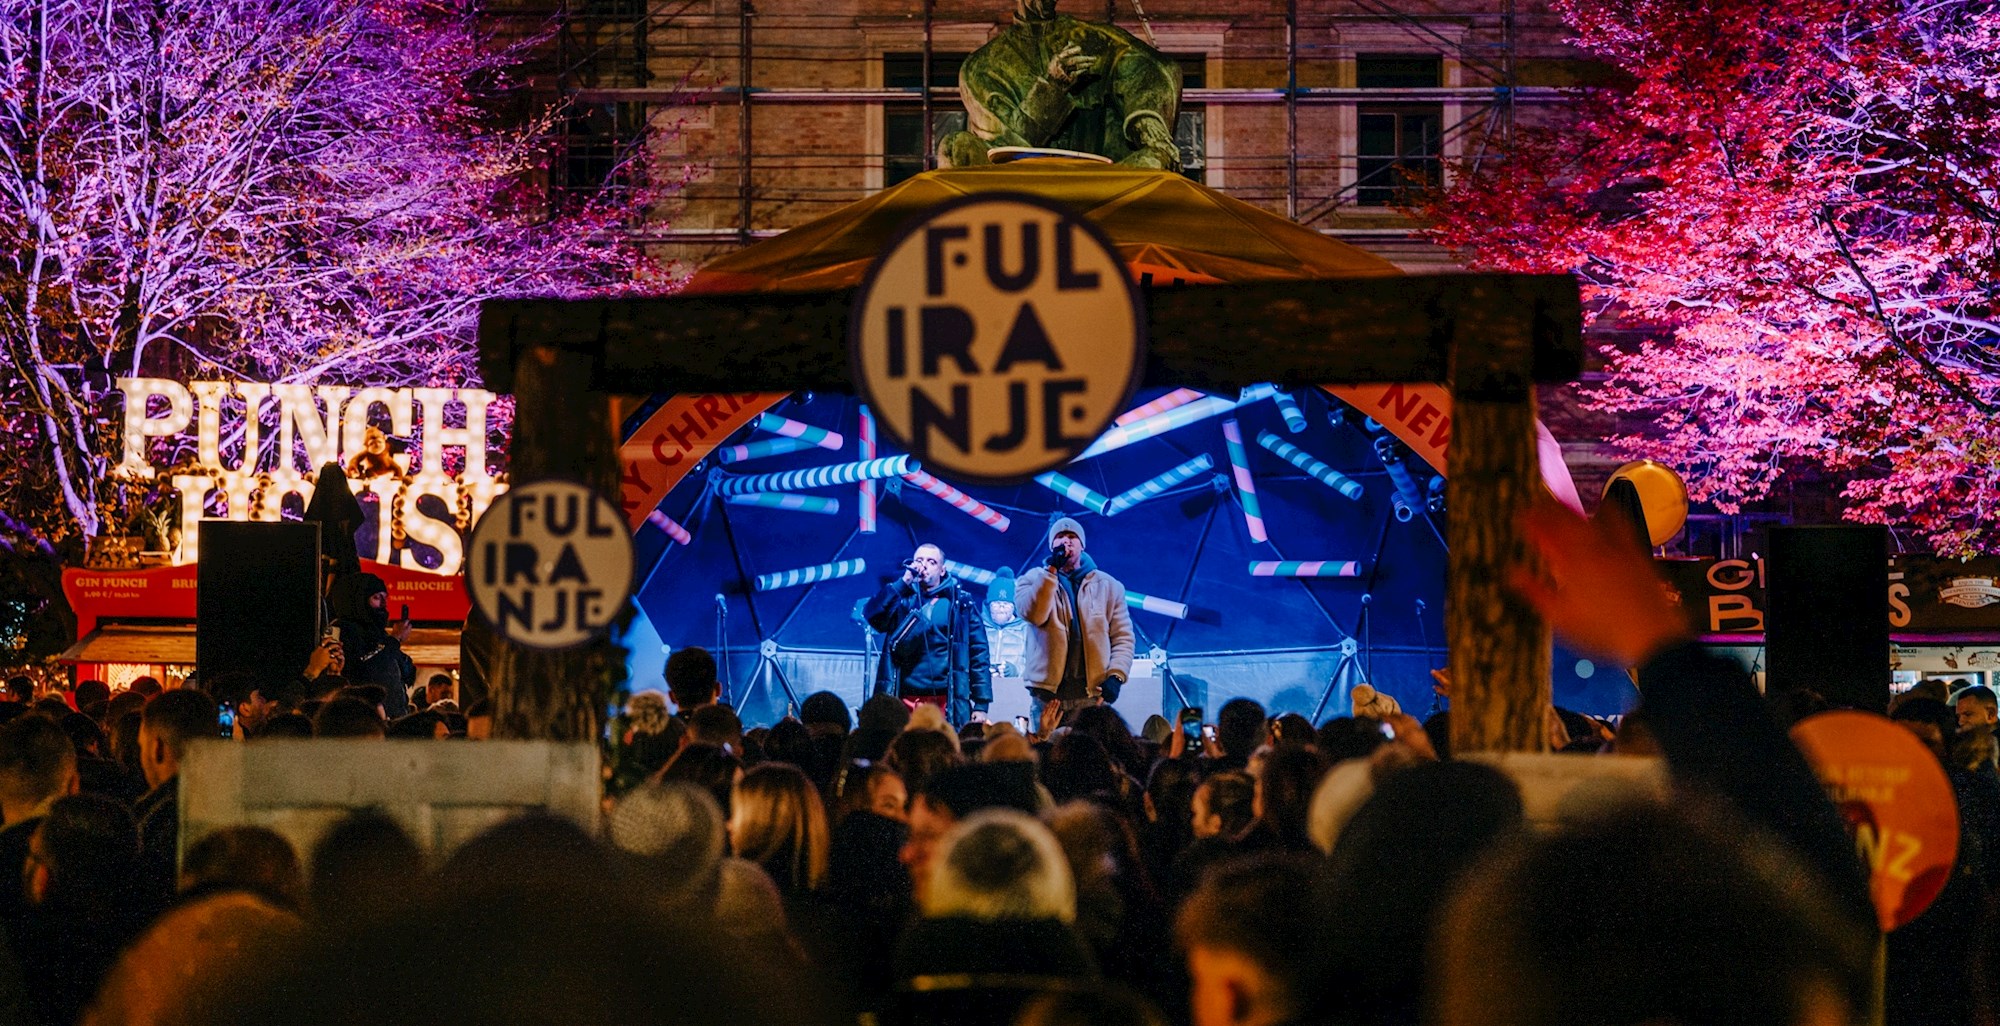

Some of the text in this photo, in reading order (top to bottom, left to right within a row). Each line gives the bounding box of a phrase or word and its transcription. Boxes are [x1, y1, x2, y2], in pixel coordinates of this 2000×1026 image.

[926, 221, 1100, 297] FUL
[887, 301, 1063, 378] IRA
[116, 377, 497, 482] PUNCH
[911, 377, 1087, 454] NJE
[510, 493, 613, 537] FUL
[76, 578, 148, 588] GIN PUNCH
[397, 581, 454, 590] BRIOCHE
[484, 541, 589, 586] IRA
[497, 588, 603, 632] NJE
